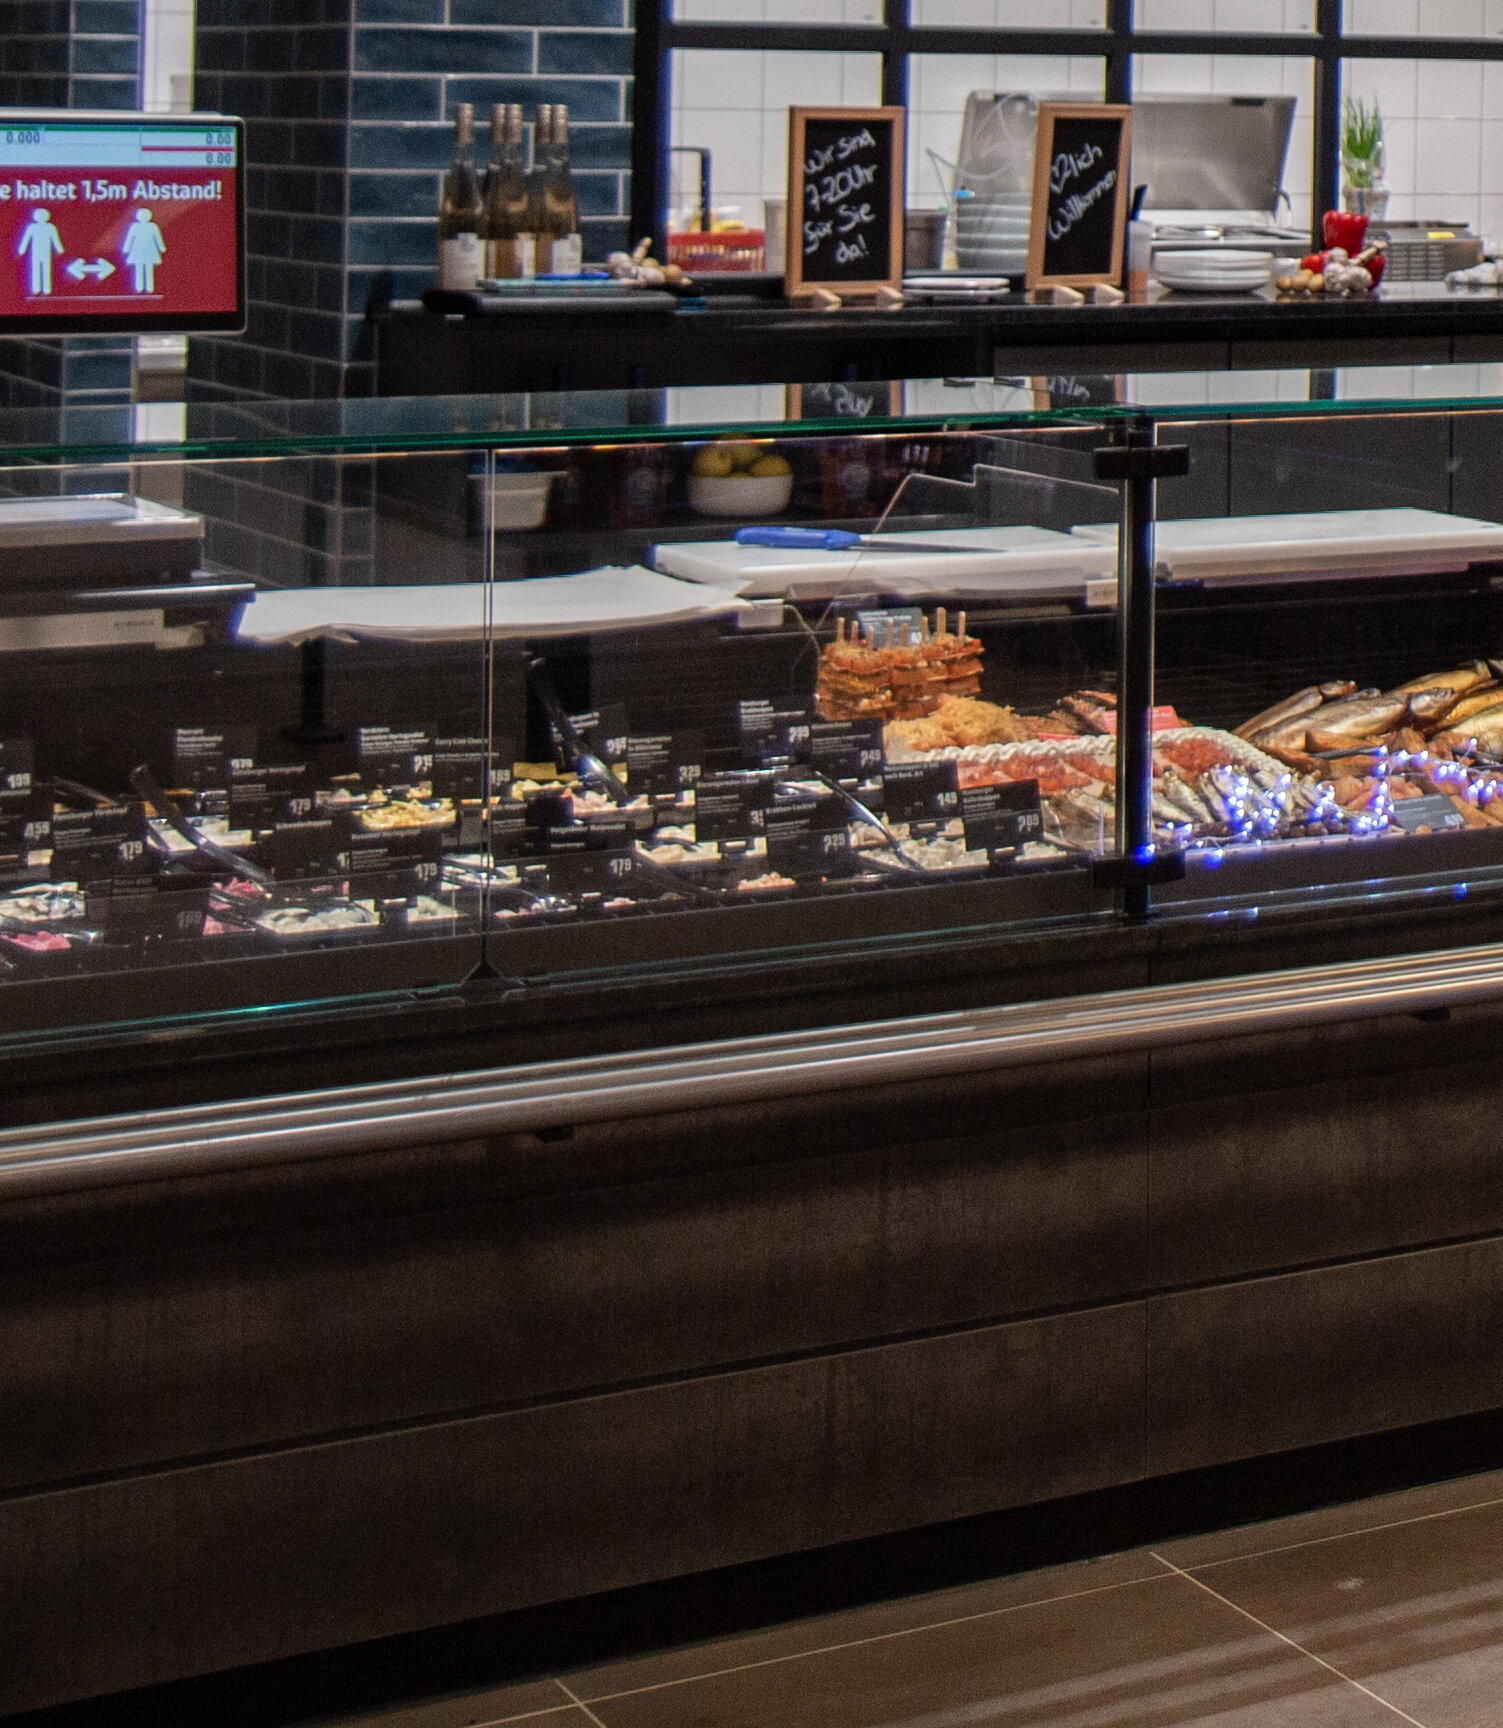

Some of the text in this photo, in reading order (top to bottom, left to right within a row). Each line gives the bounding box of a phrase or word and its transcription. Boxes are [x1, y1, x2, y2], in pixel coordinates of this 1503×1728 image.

[16, 179, 76, 200] haltet
[82, 180, 126, 203] 1,5m
[133, 179, 222, 201] Abstand!
